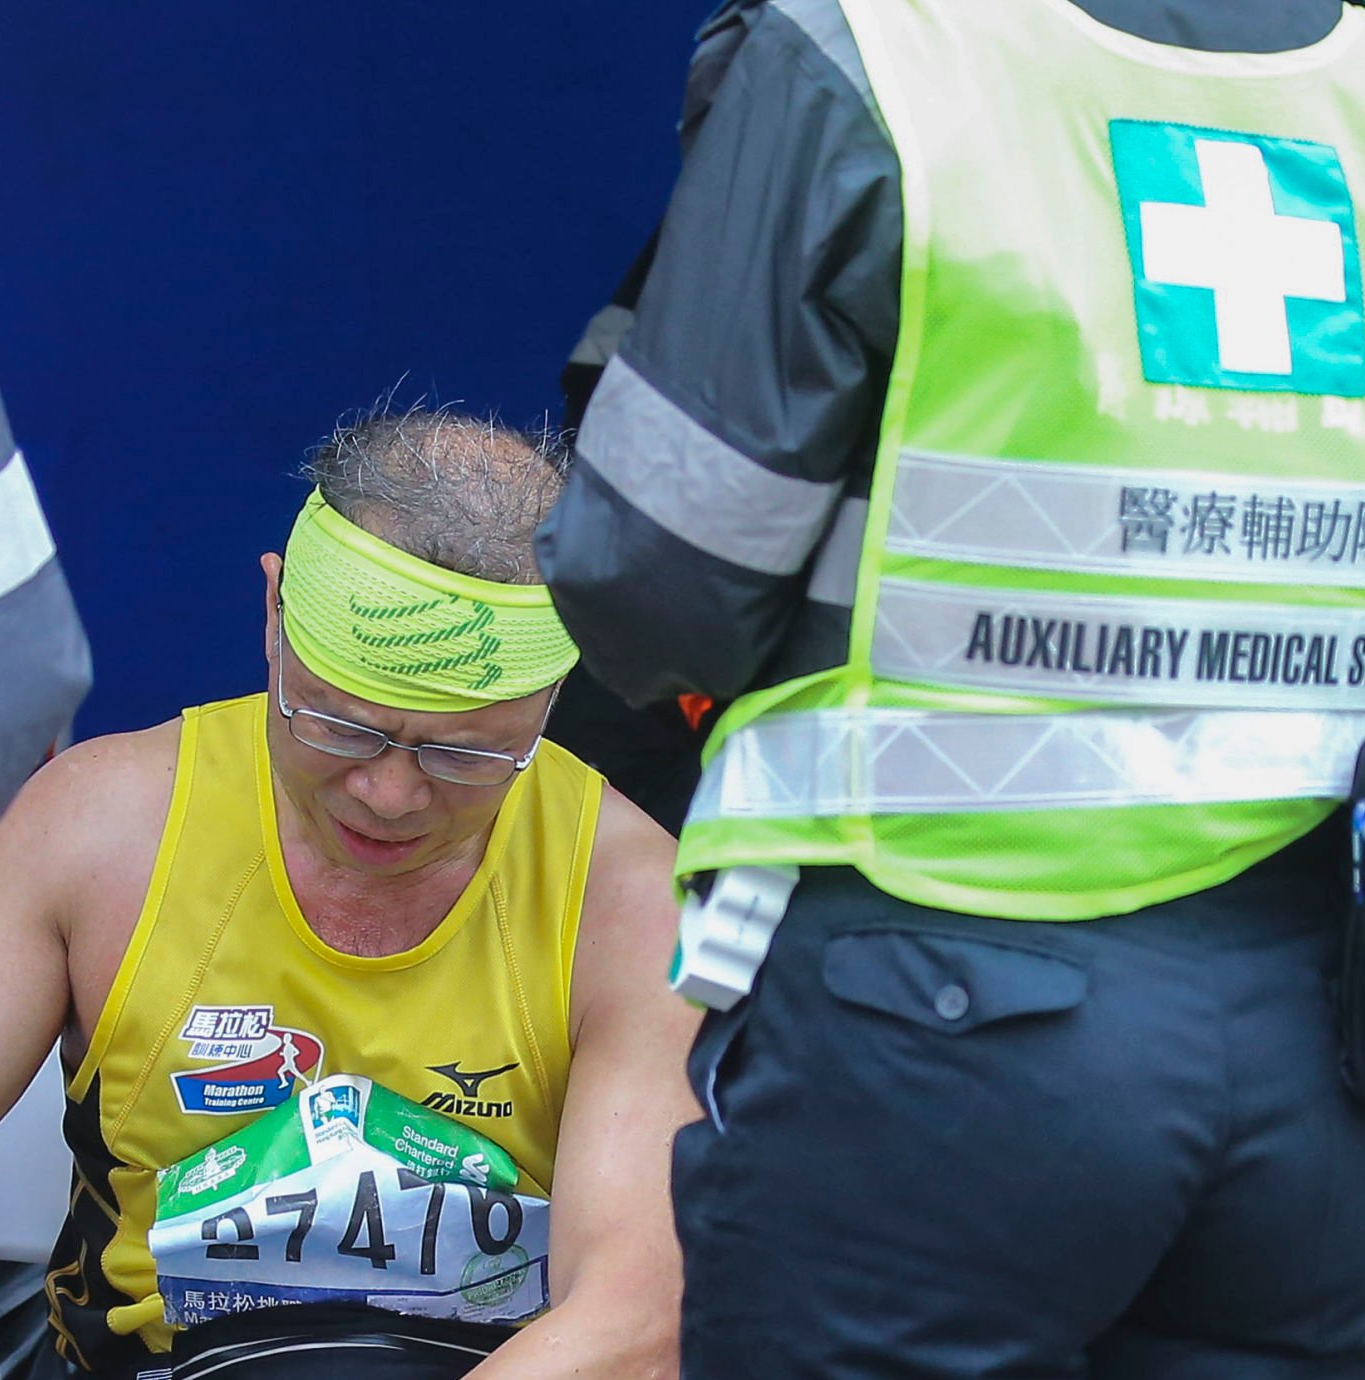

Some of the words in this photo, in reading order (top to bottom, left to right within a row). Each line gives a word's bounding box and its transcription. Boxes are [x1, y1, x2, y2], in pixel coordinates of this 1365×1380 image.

[966, 612, 1189, 681] AUXILIARY
[1195, 629, 1340, 686] MEDICAL
[186, 1010, 268, 1039] 馬拉松
[191, 1041, 253, 1058] 訓練中心
[204, 1084, 265, 1097] Marathon
[204, 1097, 236, 1108] Training
[237, 1096, 265, 1107] Centre
[402, 1125, 459, 1158] Standard
